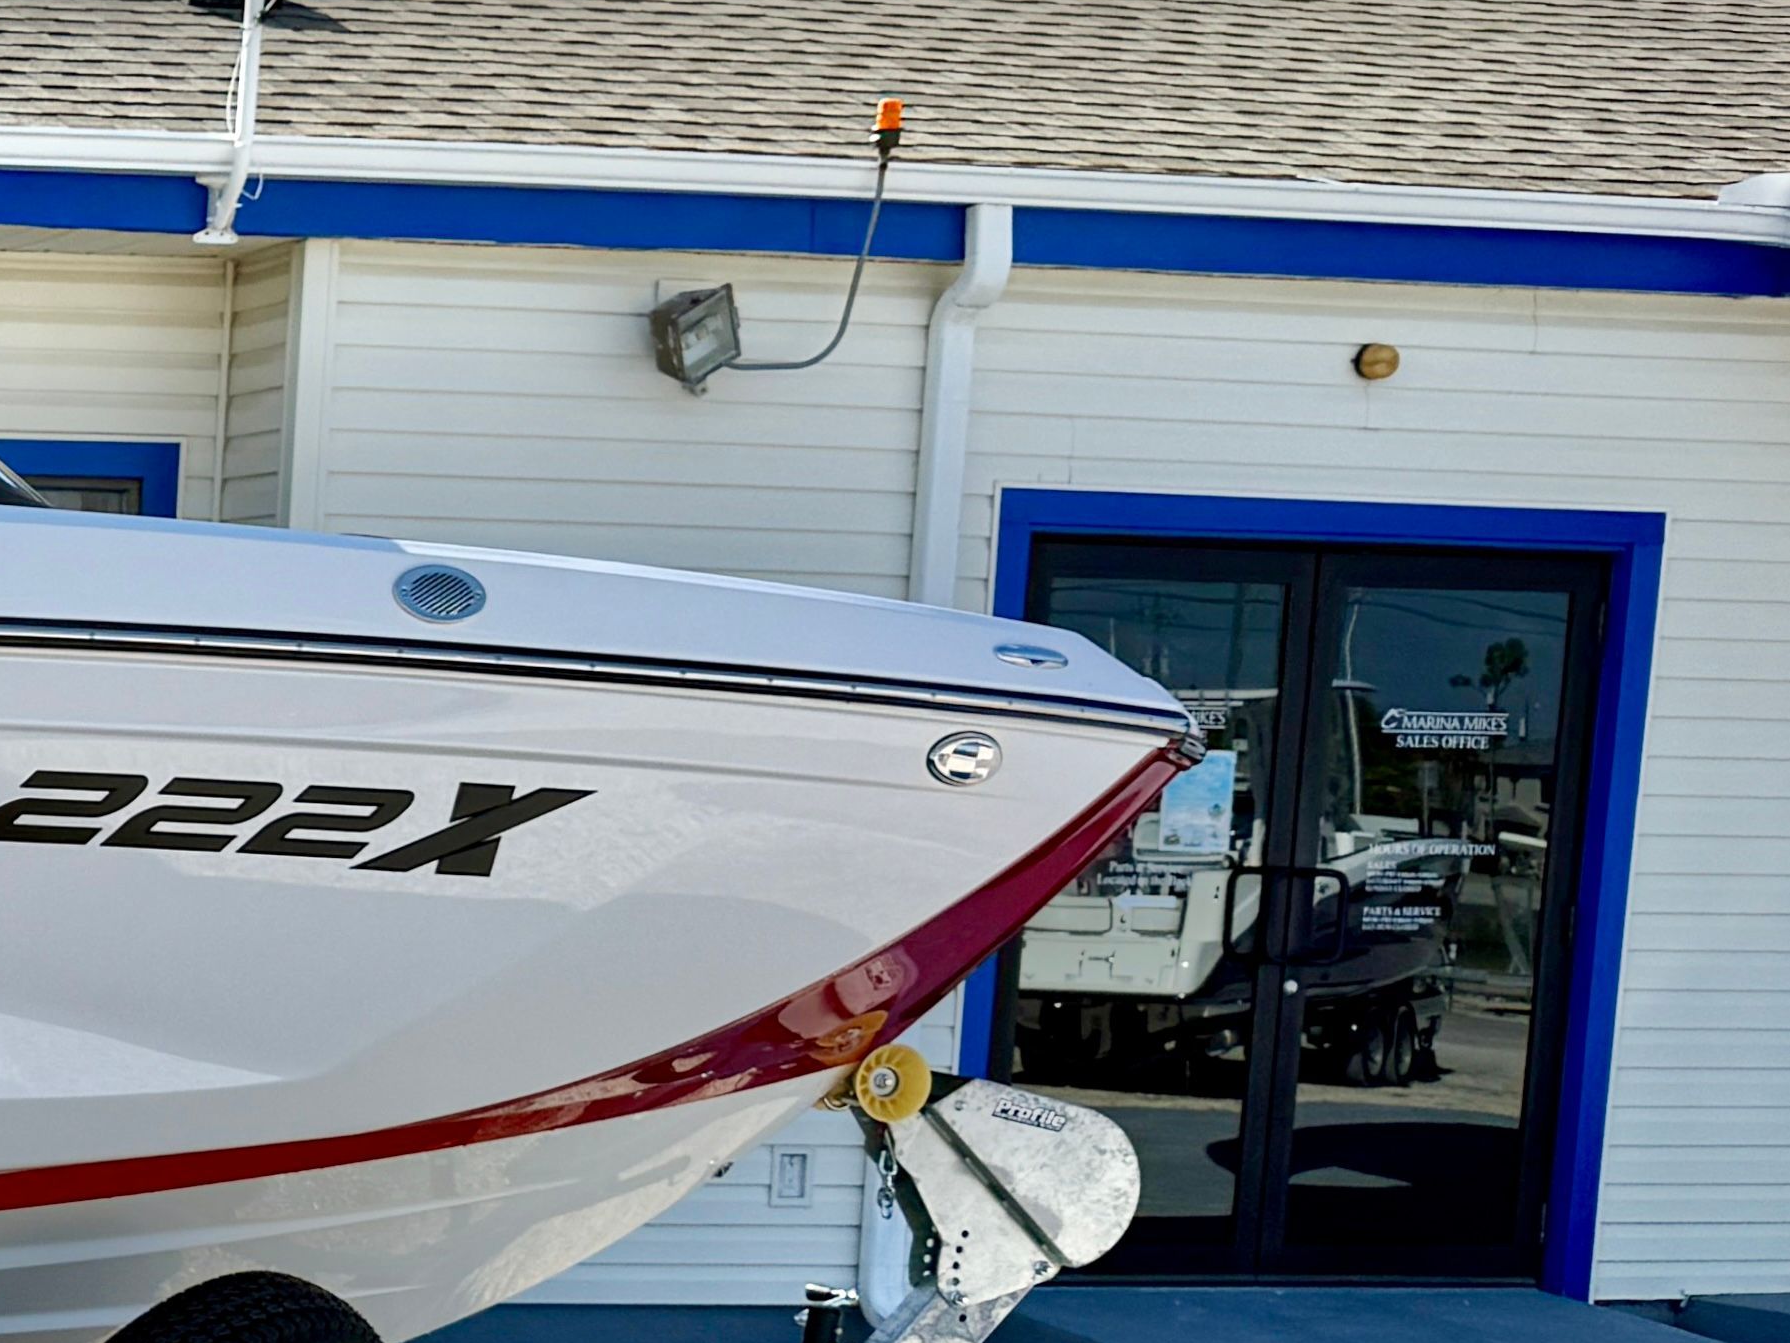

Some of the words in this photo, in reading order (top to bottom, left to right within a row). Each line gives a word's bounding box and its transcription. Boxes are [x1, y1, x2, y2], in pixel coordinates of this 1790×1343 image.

[1402, 715, 1460, 730] MARINA
[1463, 717, 1507, 731] MIKE'S
[1395, 735, 1438, 748] SALES
[1442, 736, 1489, 749] OFFICE
[1429, 844, 1496, 856] OPERATION
[994, 1099, 1066, 1127] Profile
